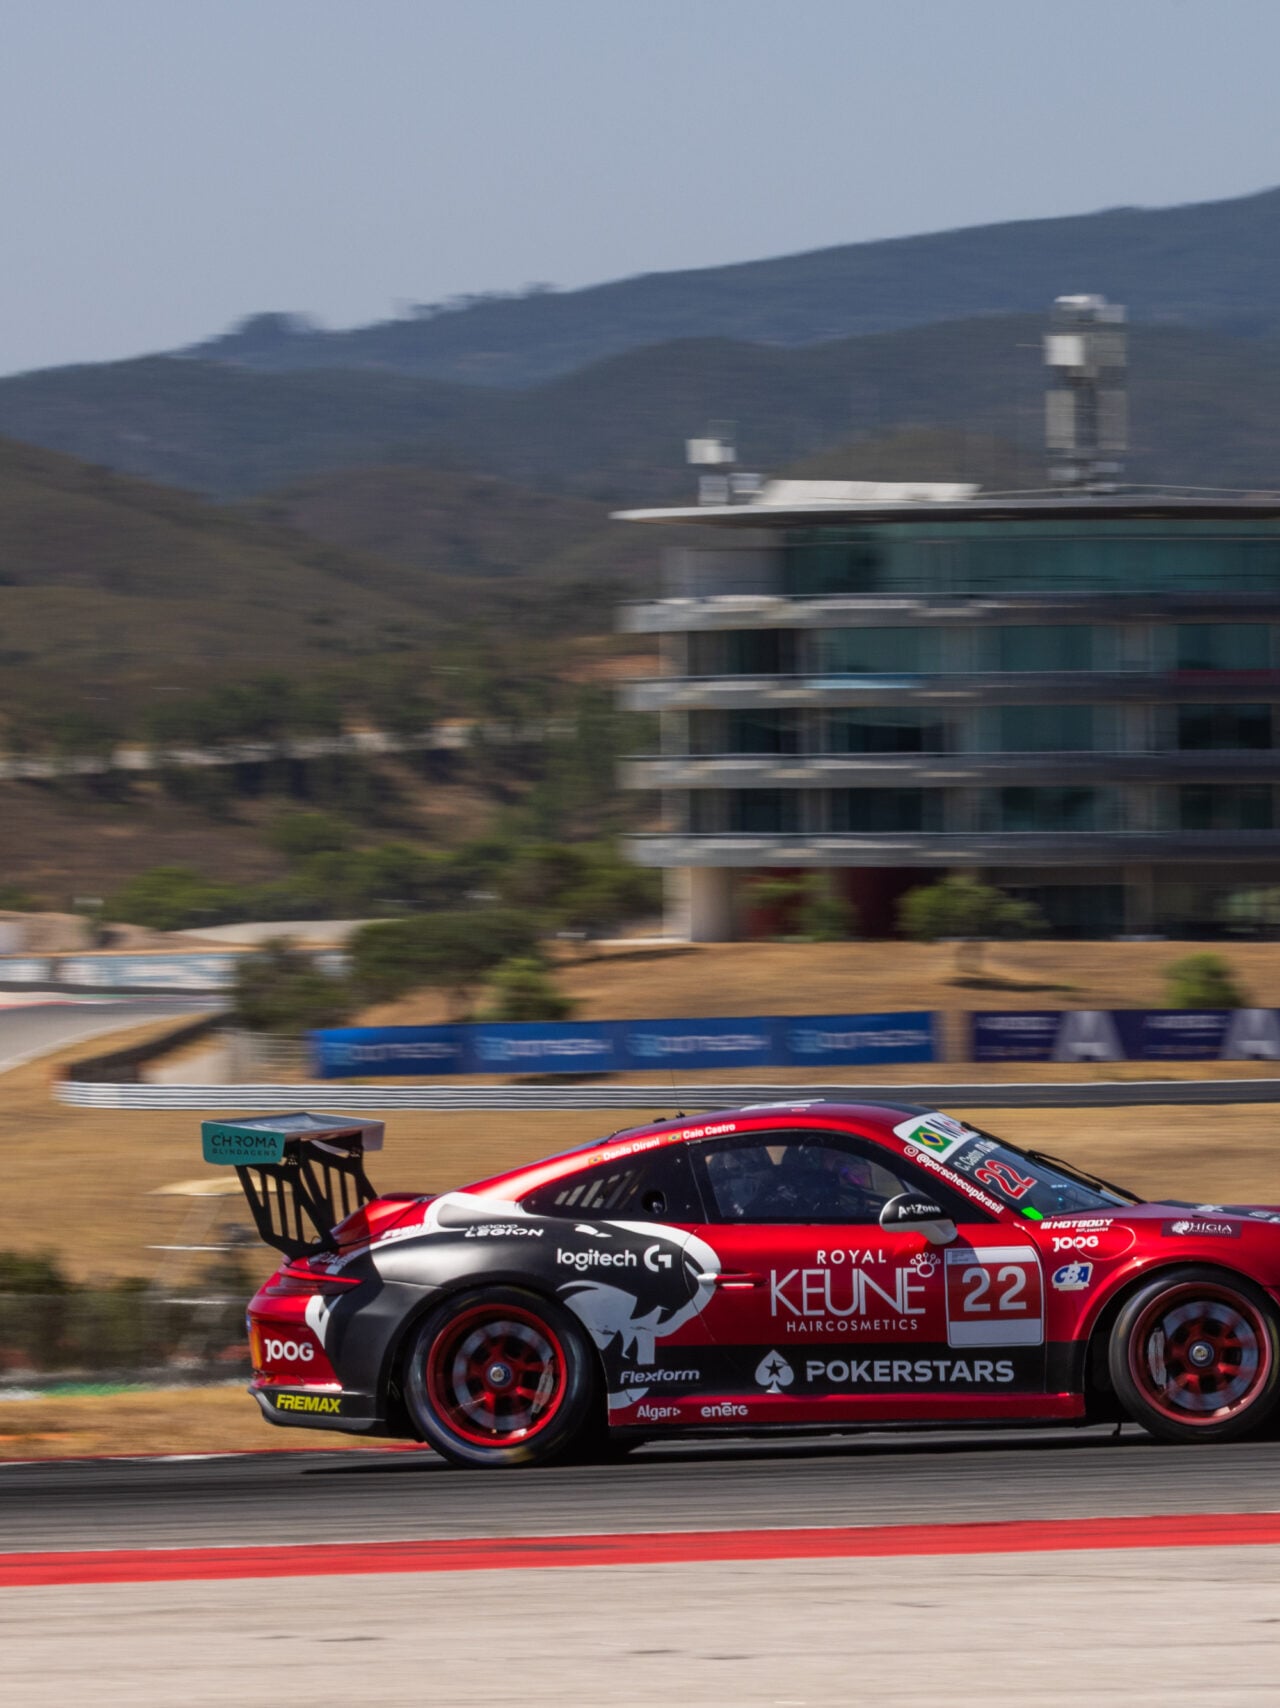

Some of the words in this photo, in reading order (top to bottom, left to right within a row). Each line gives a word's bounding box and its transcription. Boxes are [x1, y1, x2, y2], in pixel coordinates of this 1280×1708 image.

[683, 1129, 704, 1139] Caio
[705, 1123, 736, 1135] Castro
[211, 1134, 277, 1148] CHROMA
[212, 1148, 277, 1157] BLINDAGENS
[916, 1151, 1005, 1214] @porschecupbrasil
[974, 1159, 1038, 1200] 22
[1052, 1218, 1114, 1229] HOTBODY
[465, 1228, 544, 1238] LEGION
[557, 1247, 637, 1272] logitech
[816, 1249, 887, 1265] ROYAL
[770, 1267, 926, 1317] KEUNE
[962, 1265, 1027, 1313] 22
[786, 1319, 918, 1332] HAIRCOSMETICS
[620, 1369, 700, 1384] Flexform
[806, 1360, 1015, 1383] POKERSTARS
[276, 1393, 342, 1413] FREMAX
[636, 1404, 672, 1420] Algar
